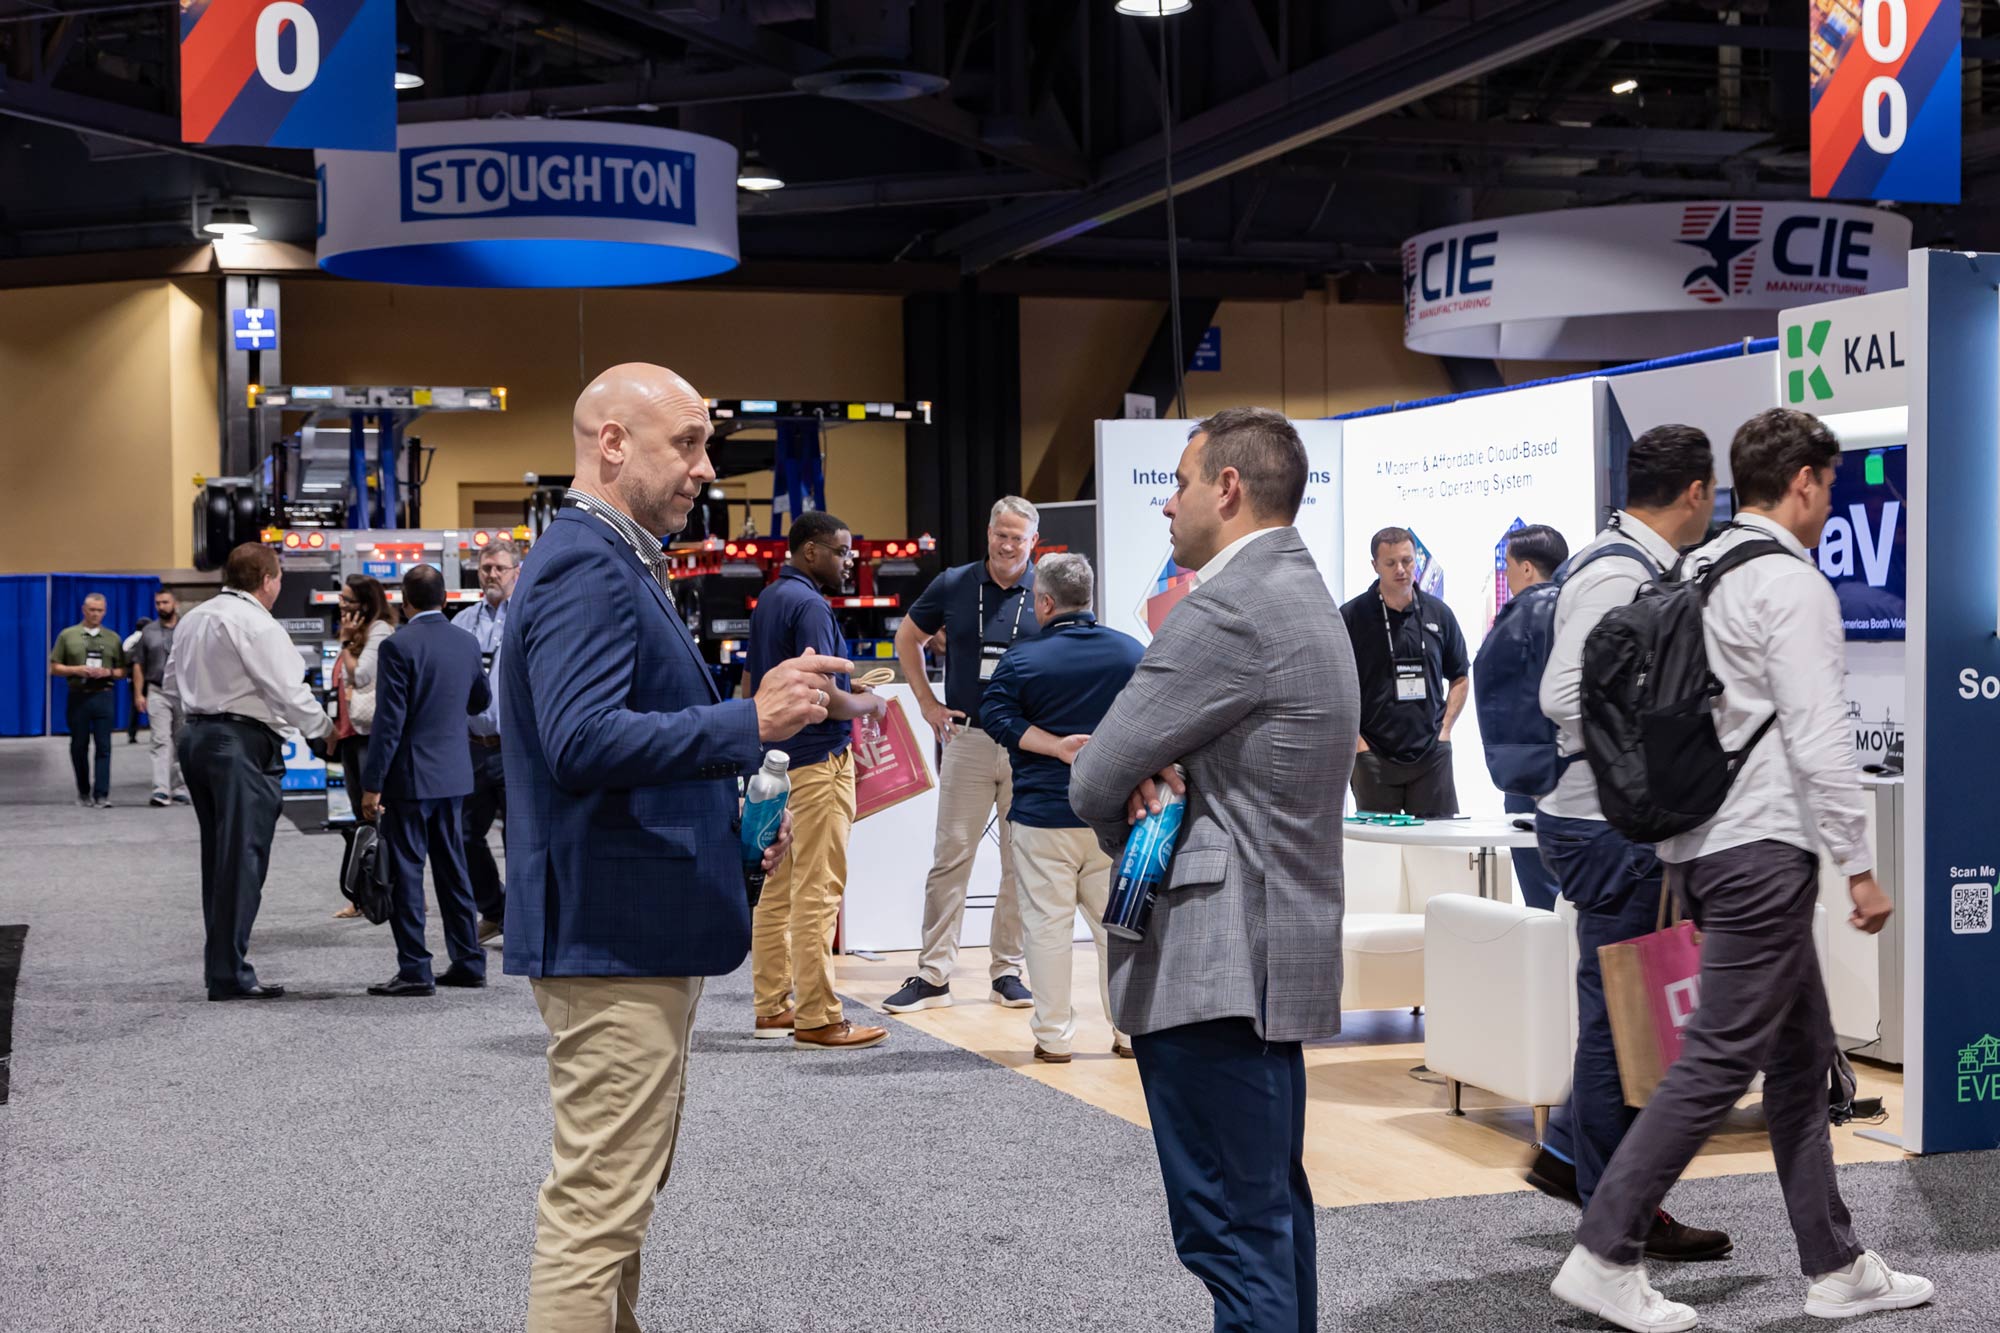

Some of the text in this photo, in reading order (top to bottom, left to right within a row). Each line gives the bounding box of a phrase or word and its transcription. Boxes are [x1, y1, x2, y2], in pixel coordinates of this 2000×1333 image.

[416, 155, 682, 209] STOUGHTON
[1773, 216, 1874, 281] CIE
[1422, 231, 1499, 302] CIE
[1766, 281, 1867, 295] MANUFACTURING
[1419, 297, 1491, 319] MANUFACTURING
[1844, 331, 1905, 374] KAL
[1433, 450, 1485, 470] Affordable
[1487, 436, 1558, 463] Cloud-Based
[1440, 477, 1490, 497] Operating
[1493, 472, 1533, 494] System
[1818, 501, 1900, 587] aV
[1871, 618, 1890, 629] Booth
[1959, 668, 2000, 699] So
[1950, 865, 1996, 878] Scan Me
